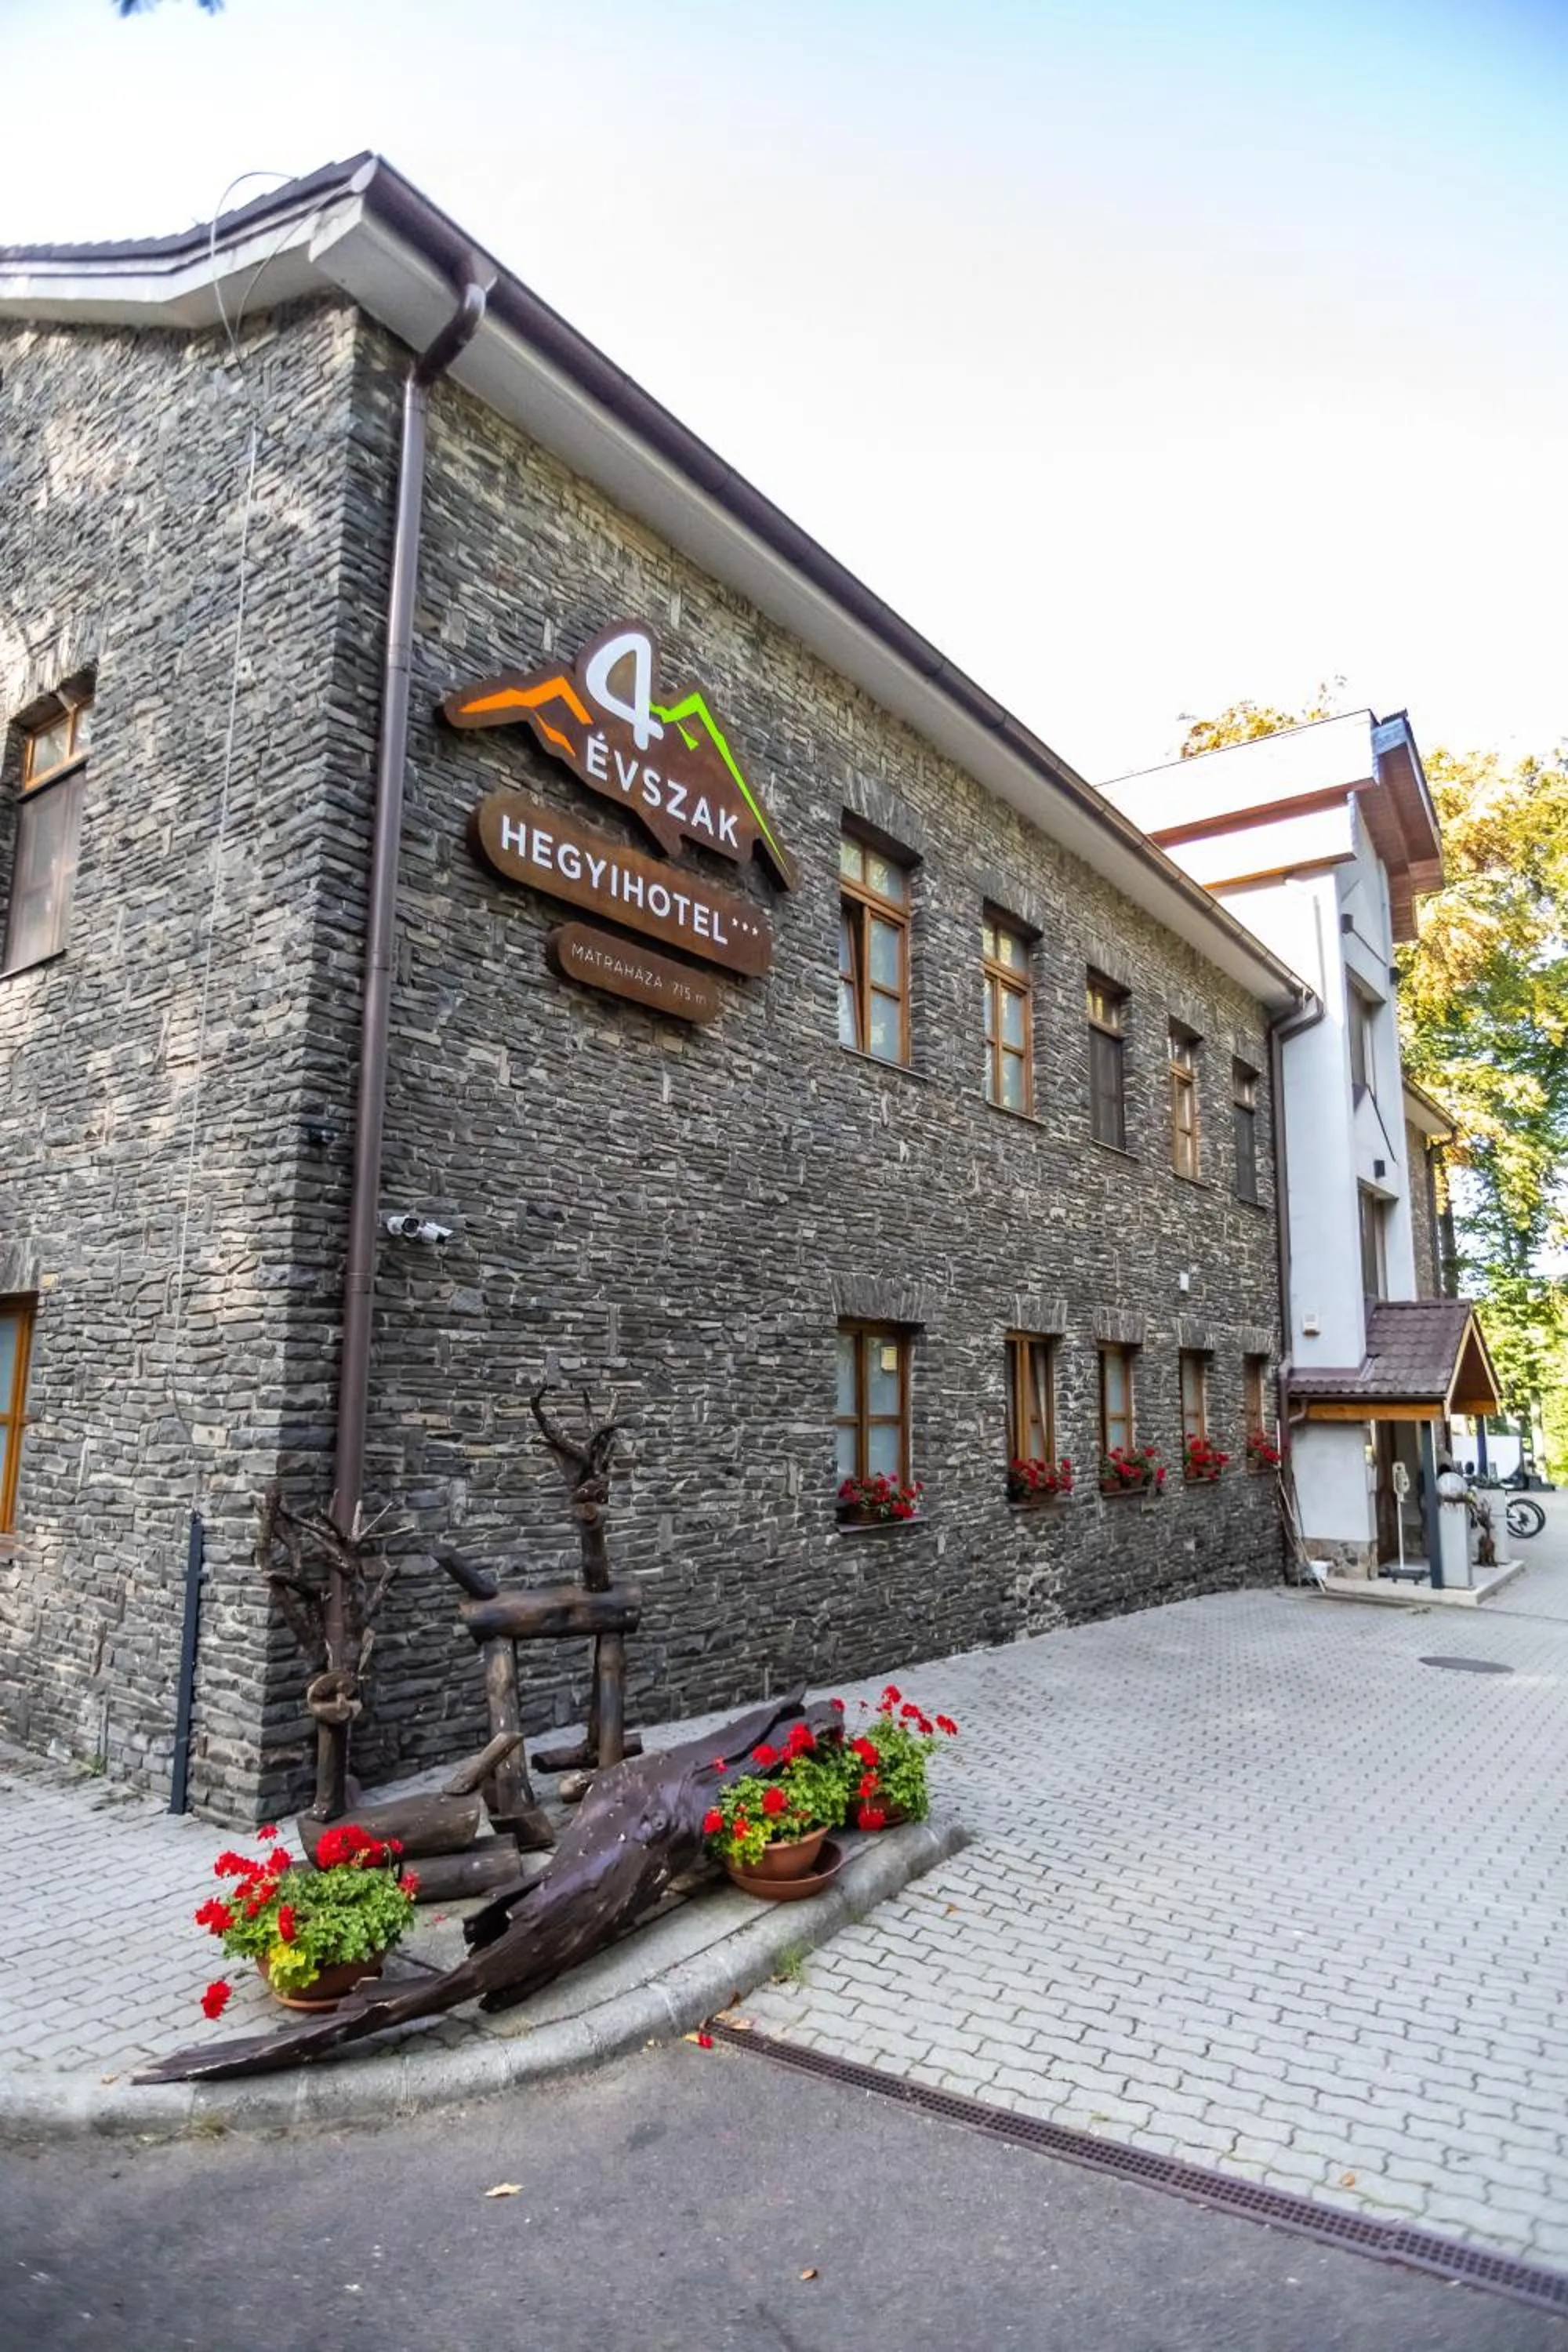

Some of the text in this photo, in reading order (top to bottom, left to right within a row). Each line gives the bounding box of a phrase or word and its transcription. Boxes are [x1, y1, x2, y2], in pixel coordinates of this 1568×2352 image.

[586, 633, 665, 750] 4
[586, 731, 740, 849] ÉVSZAK
[500, 814, 728, 945] HEGYIHOTEL
[673, 981, 691, 1001] 715
